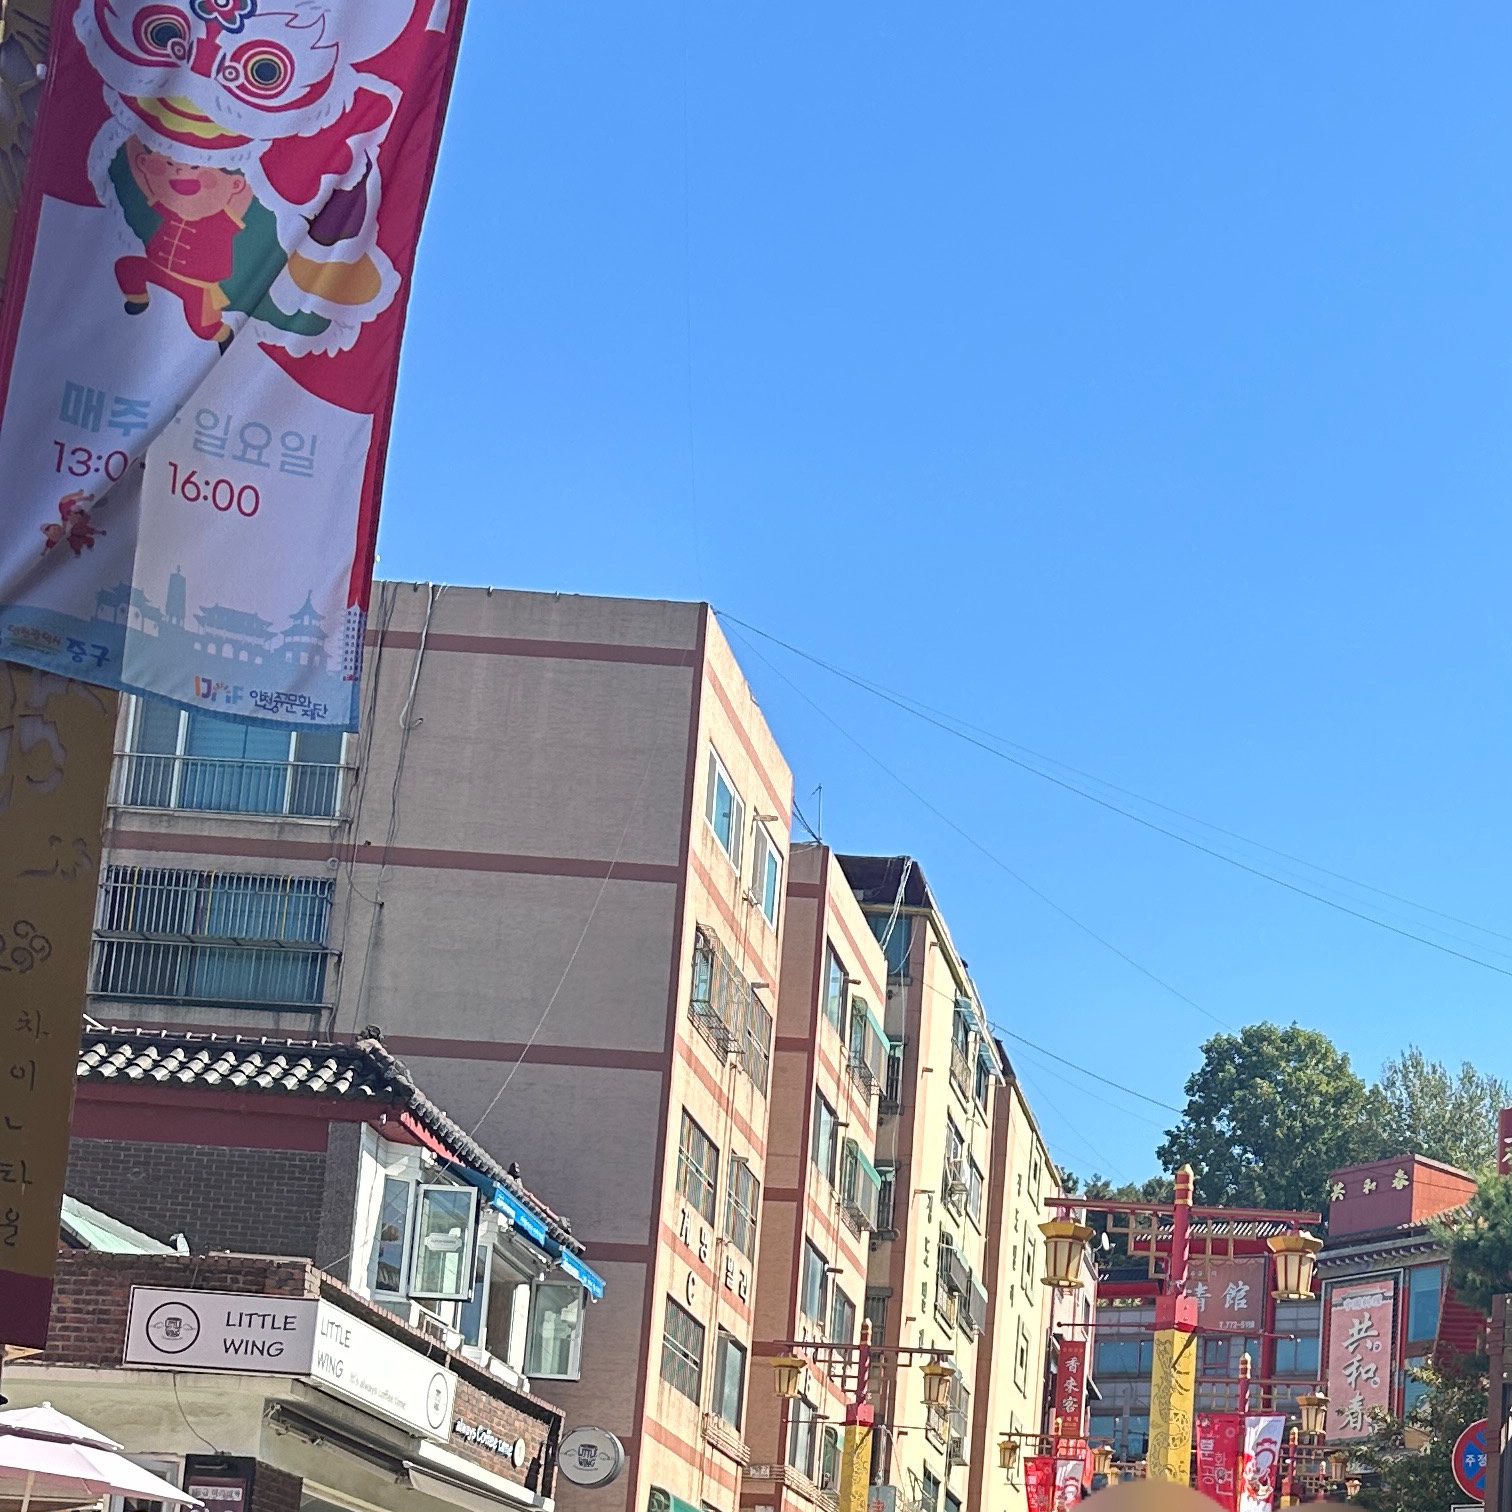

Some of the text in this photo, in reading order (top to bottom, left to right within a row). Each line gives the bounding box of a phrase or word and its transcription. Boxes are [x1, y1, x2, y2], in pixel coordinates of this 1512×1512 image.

[58, 380, 150, 437] 매주
[54, 440, 260, 517] 13:0 16:00
[65, 636, 111, 668] 중구
[225, 1310, 298, 1332] LITTLE
[320, 1316, 352, 1349] LITTLE
[223, 1338, 285, 1358] WING
[317, 1350, 344, 1379] WING
